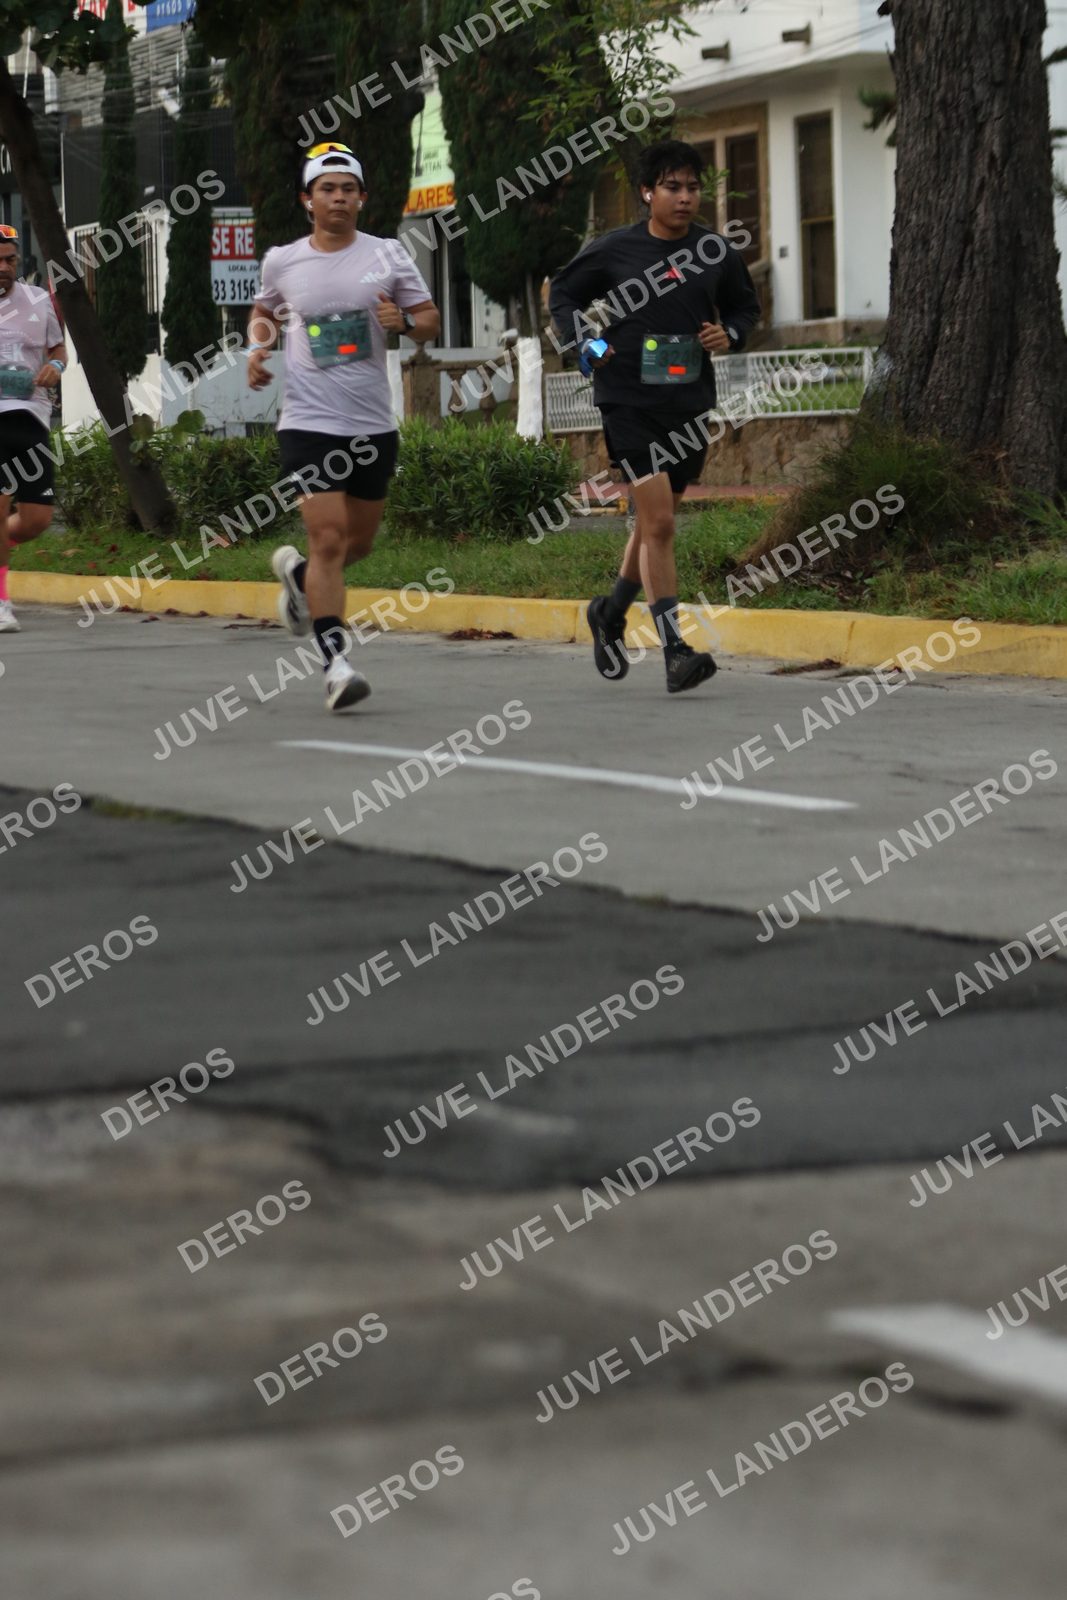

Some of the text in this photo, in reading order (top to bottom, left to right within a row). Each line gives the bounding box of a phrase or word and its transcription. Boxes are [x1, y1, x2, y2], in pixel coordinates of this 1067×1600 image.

[212, 226, 230, 256] SE
[228, 264, 247, 272] LOCAL
[214, 279, 256, 301] 33 3156
